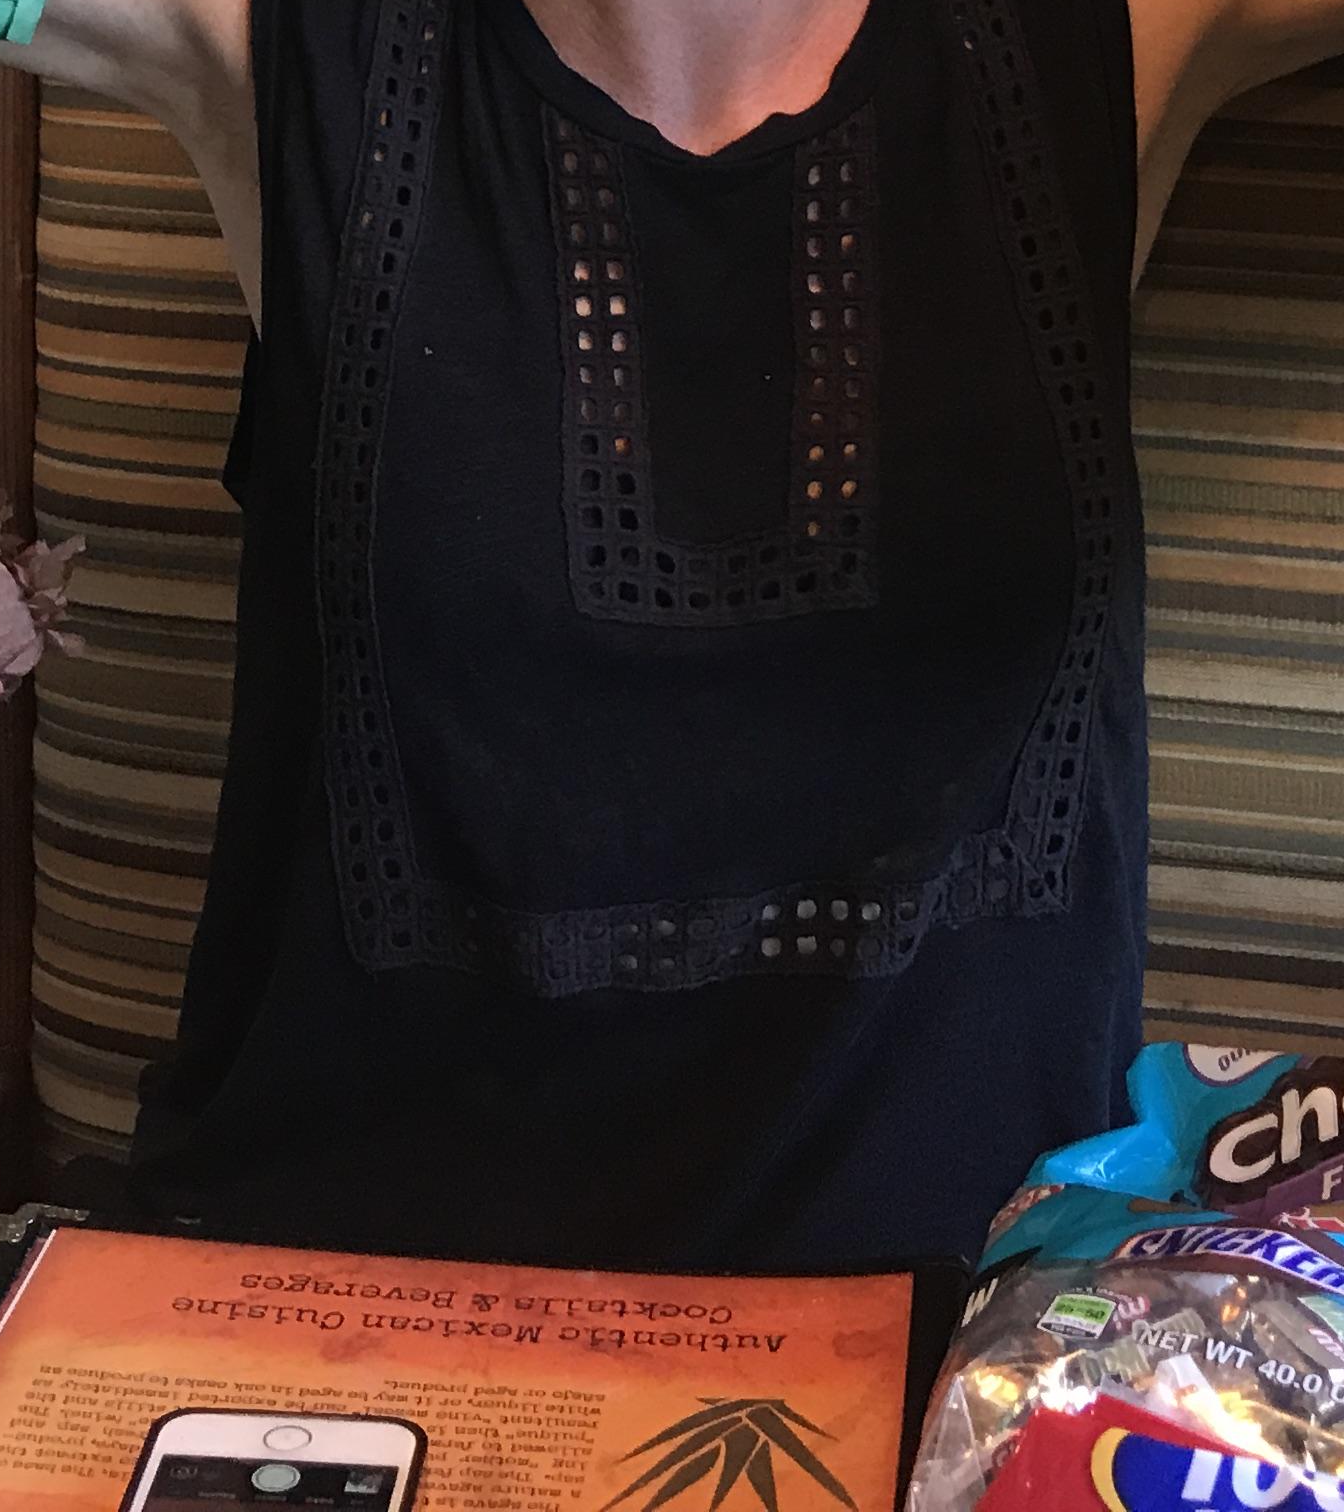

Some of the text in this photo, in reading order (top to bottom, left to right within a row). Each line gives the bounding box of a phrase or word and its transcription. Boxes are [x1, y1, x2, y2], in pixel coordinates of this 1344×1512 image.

[239, 1274, 733, 1324] Cocktails & Beverages
[170, 1296, 787, 1354] Authentic Mexican Cuisine
[1140, 1328, 1199, 1354] NET
[1205, 1337, 1254, 1370] WT
[1258, 1358, 1324, 1395] 40.0
[545, 1404, 601, 1416] white
[498, 1415, 599, 1430] resultant
[481, 1440, 502, 1452] to
[510, 1443, 593, 1456] allowed
